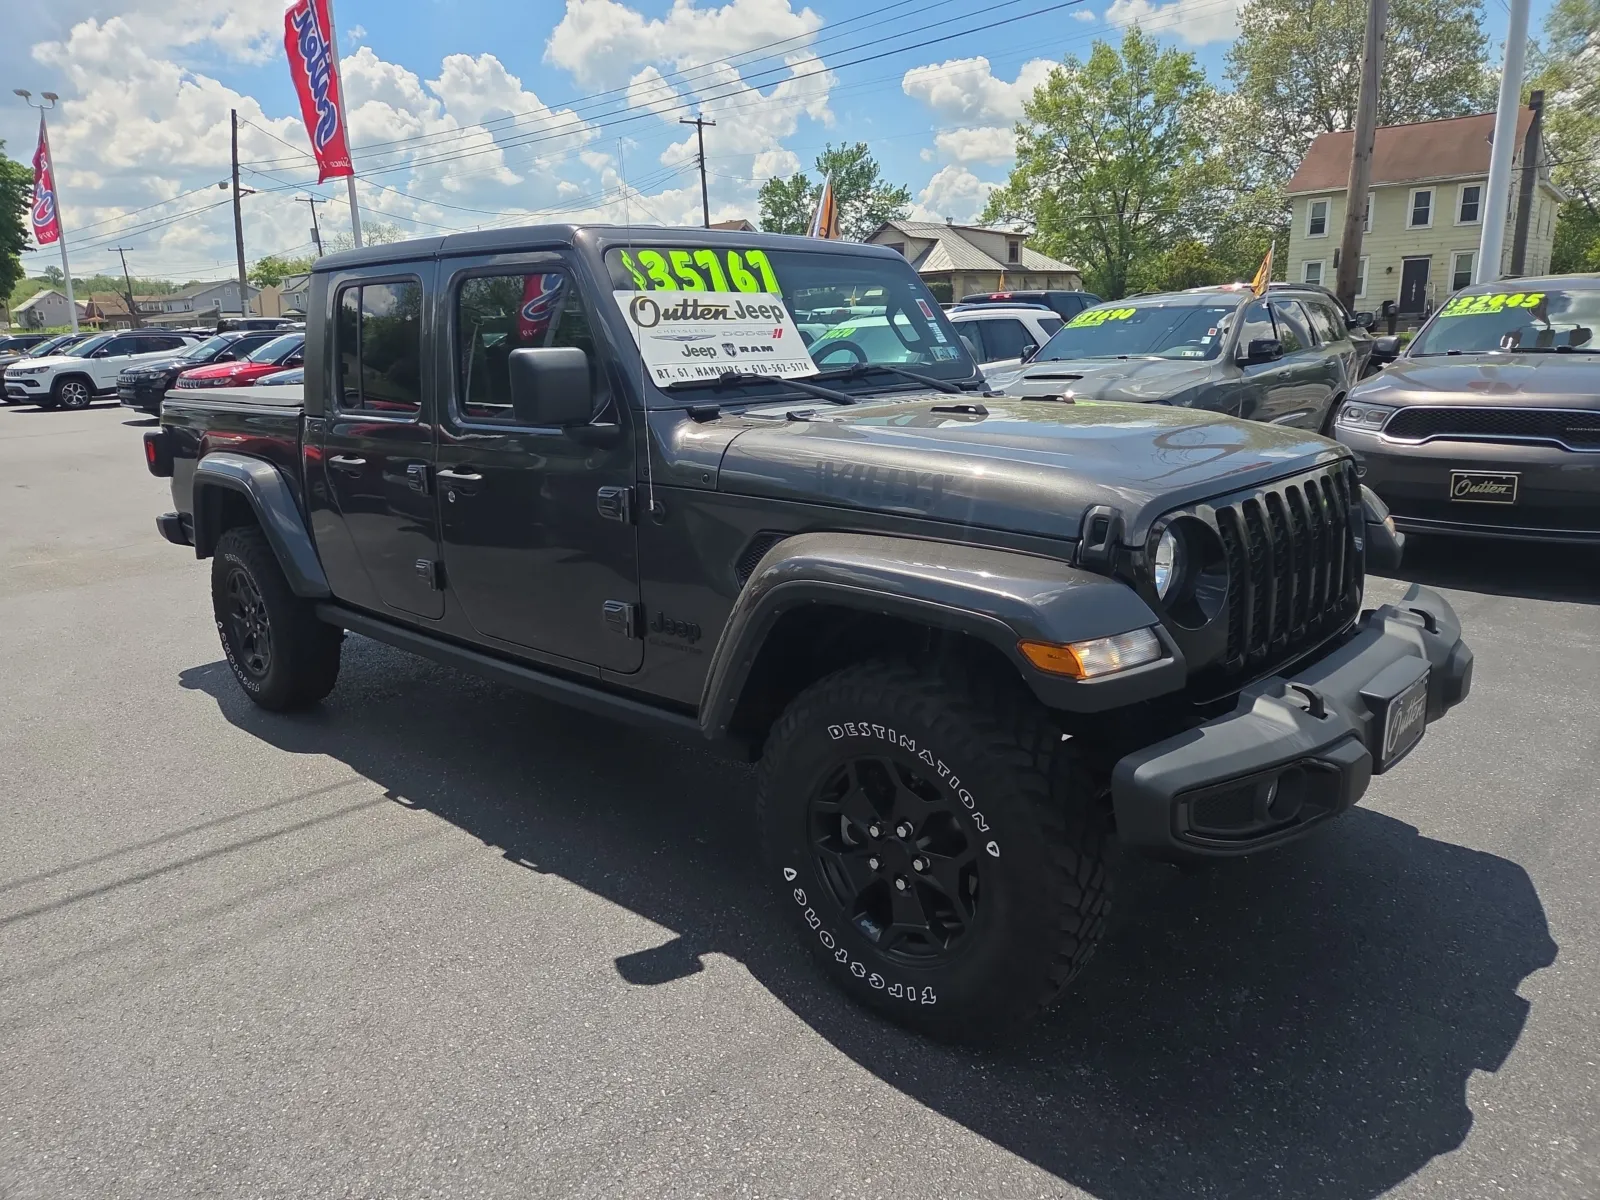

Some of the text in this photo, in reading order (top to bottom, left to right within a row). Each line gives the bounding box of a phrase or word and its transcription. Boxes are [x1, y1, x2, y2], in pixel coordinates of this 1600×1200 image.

[630, 295, 785, 328] Outten Jeep
[682, 344, 774, 359] Jeep RAM
[656, 369, 676, 379] RT.
[679, 367, 694, 379] 61,
[751, 362, 810, 374] 610-562-5174
[1454, 479, 1513, 496] Outten
[650, 611, 702, 645] Jeep
[1388, 693, 1427, 752] Outten
[828, 722, 989, 832] DESTINATION
